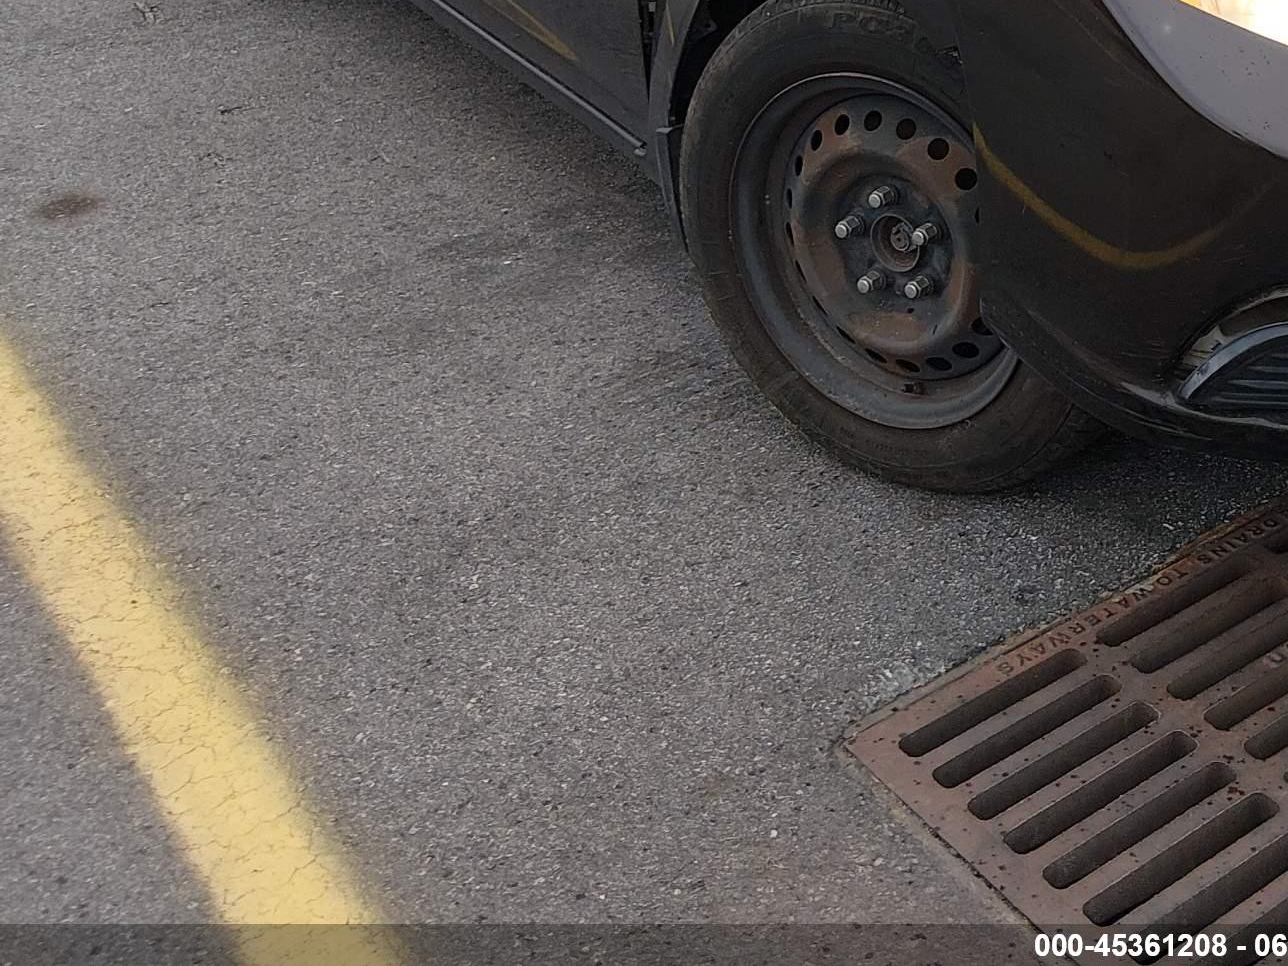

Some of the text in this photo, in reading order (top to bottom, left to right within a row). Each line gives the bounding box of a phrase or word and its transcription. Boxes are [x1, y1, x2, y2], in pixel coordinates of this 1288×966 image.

[1196, 517, 1279, 567] DRAINS
[1156, 567, 1189, 589] TO
[995, 583, 1154, 676] WATERWAYS
